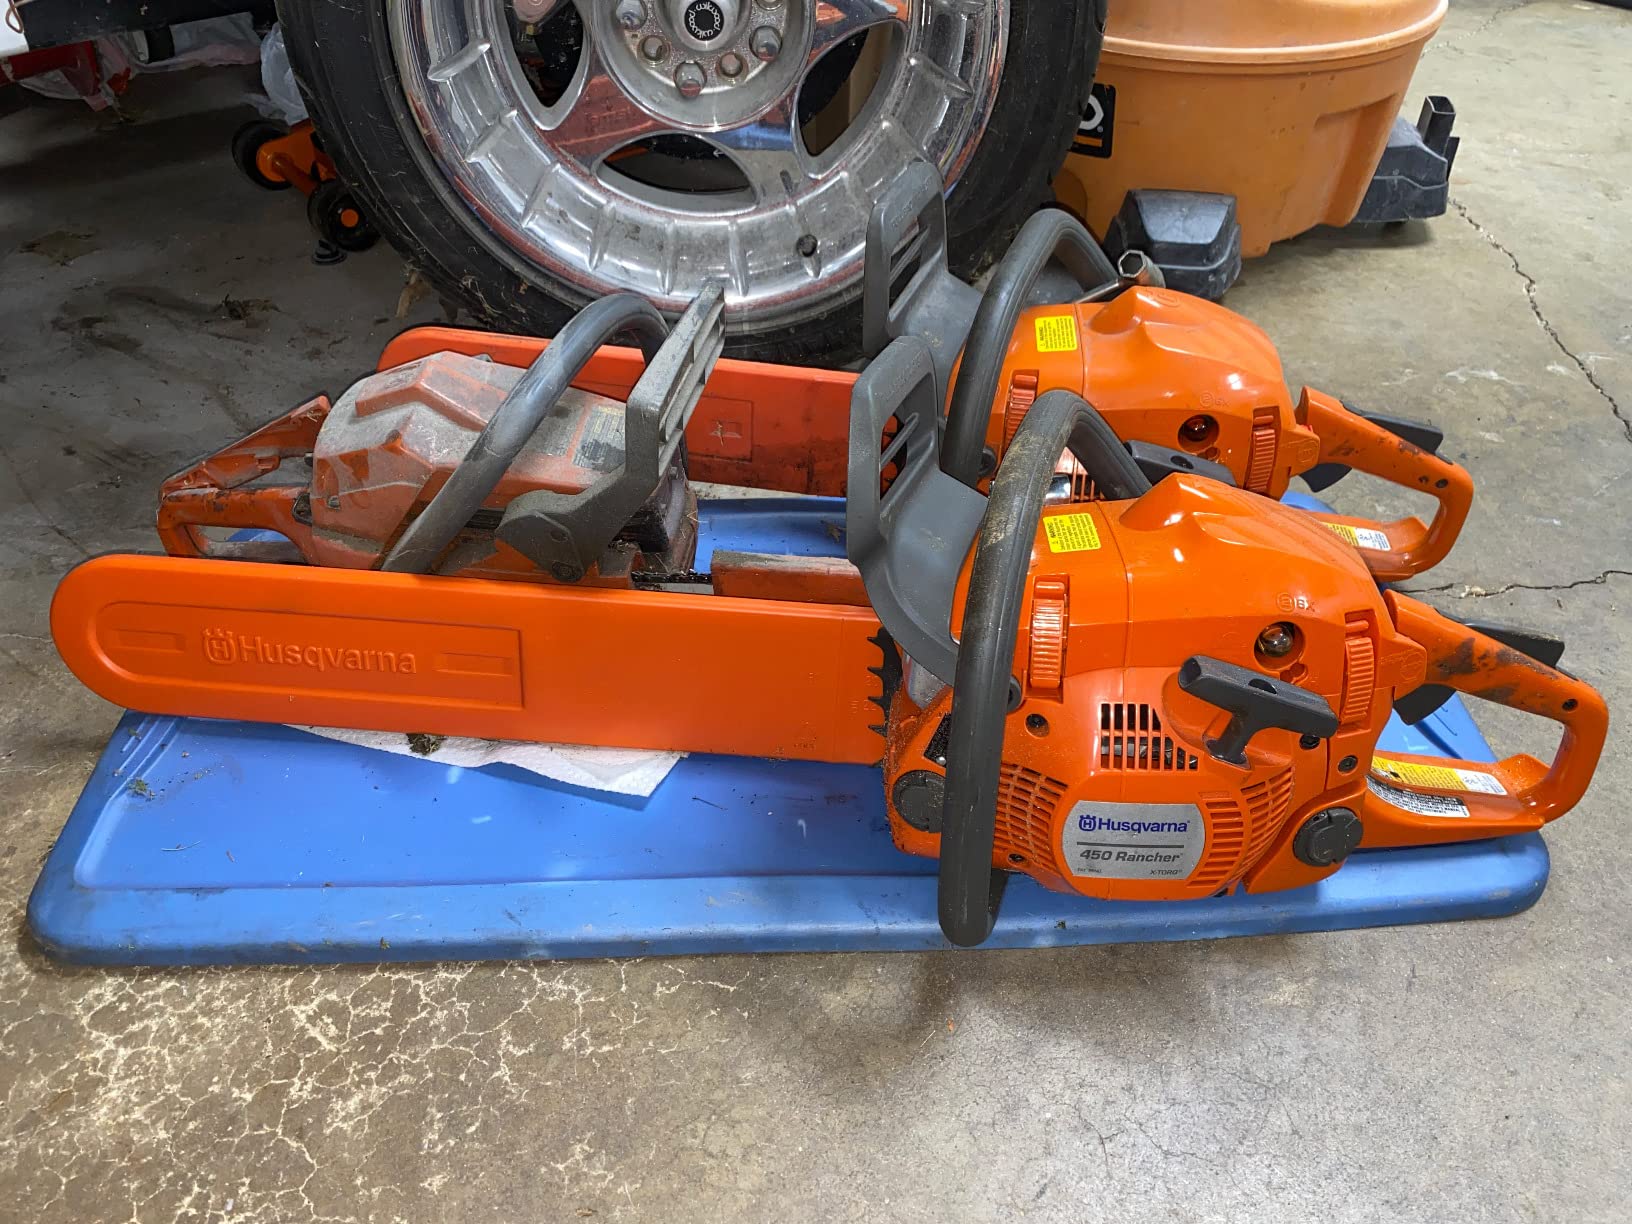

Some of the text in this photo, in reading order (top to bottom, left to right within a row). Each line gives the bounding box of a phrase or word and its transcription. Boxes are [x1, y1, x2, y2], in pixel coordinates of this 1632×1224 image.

[238, 634, 417, 674] Husqvarna
[1098, 817, 1188, 833] Husqvarna
[1080, 849, 1180, 863] 450 Rancher
